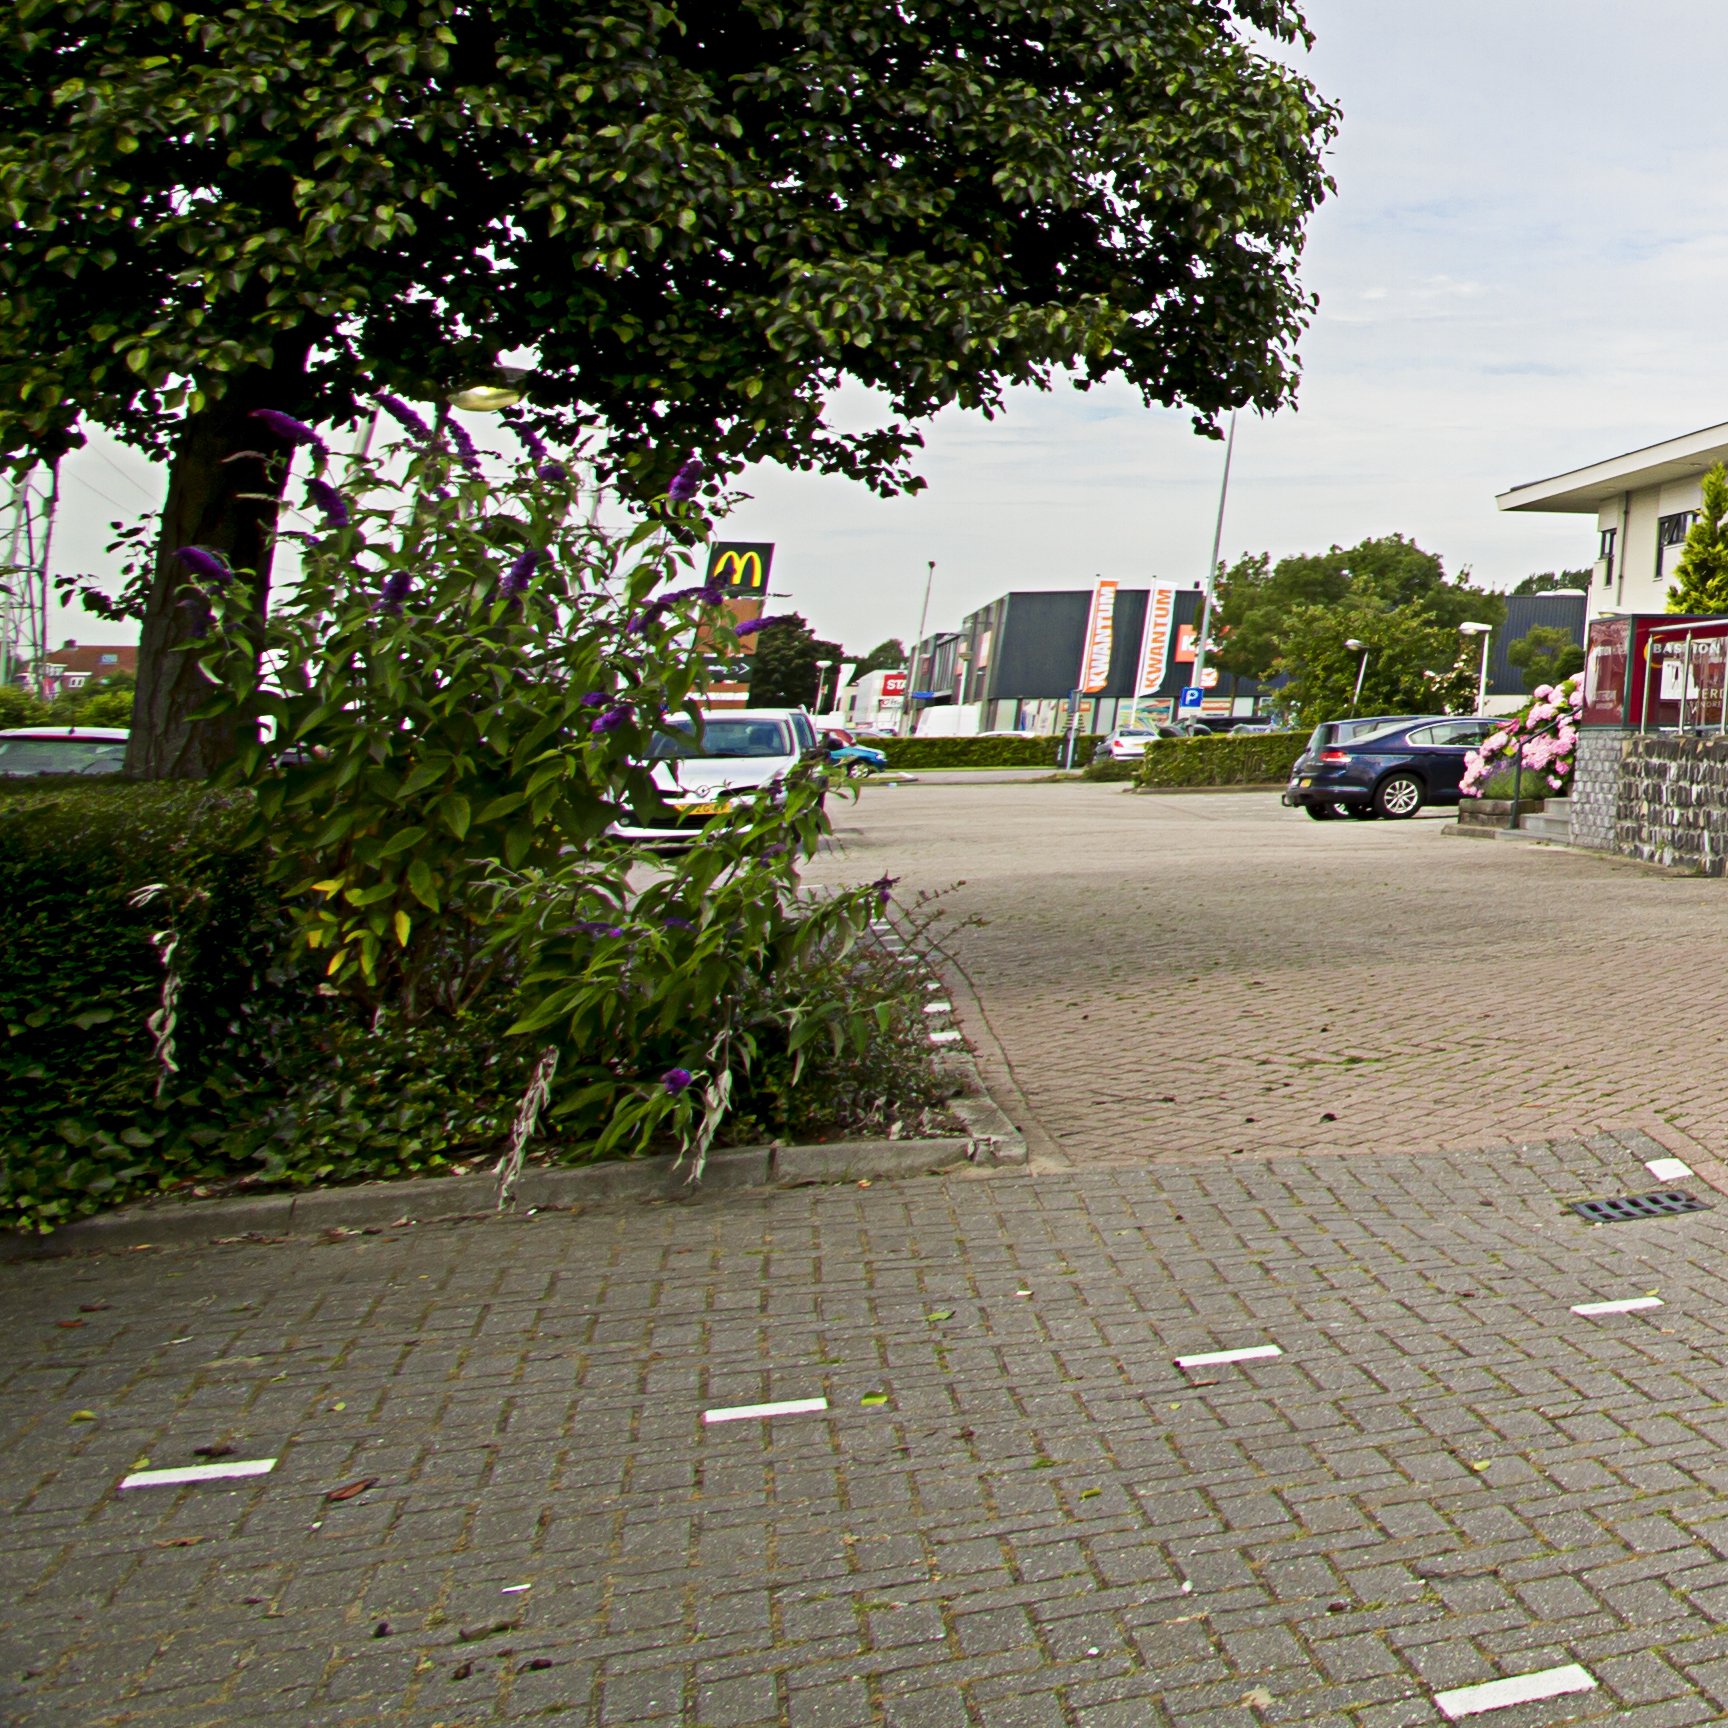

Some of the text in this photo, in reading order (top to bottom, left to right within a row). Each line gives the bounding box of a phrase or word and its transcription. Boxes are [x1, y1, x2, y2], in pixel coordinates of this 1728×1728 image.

[1088, 586, 1116, 688] KWANTUM
[1144, 589, 1172, 689] KWANTUM
[1652, 642, 1721, 655] BASION
[1185, 689, 1199, 705] P
